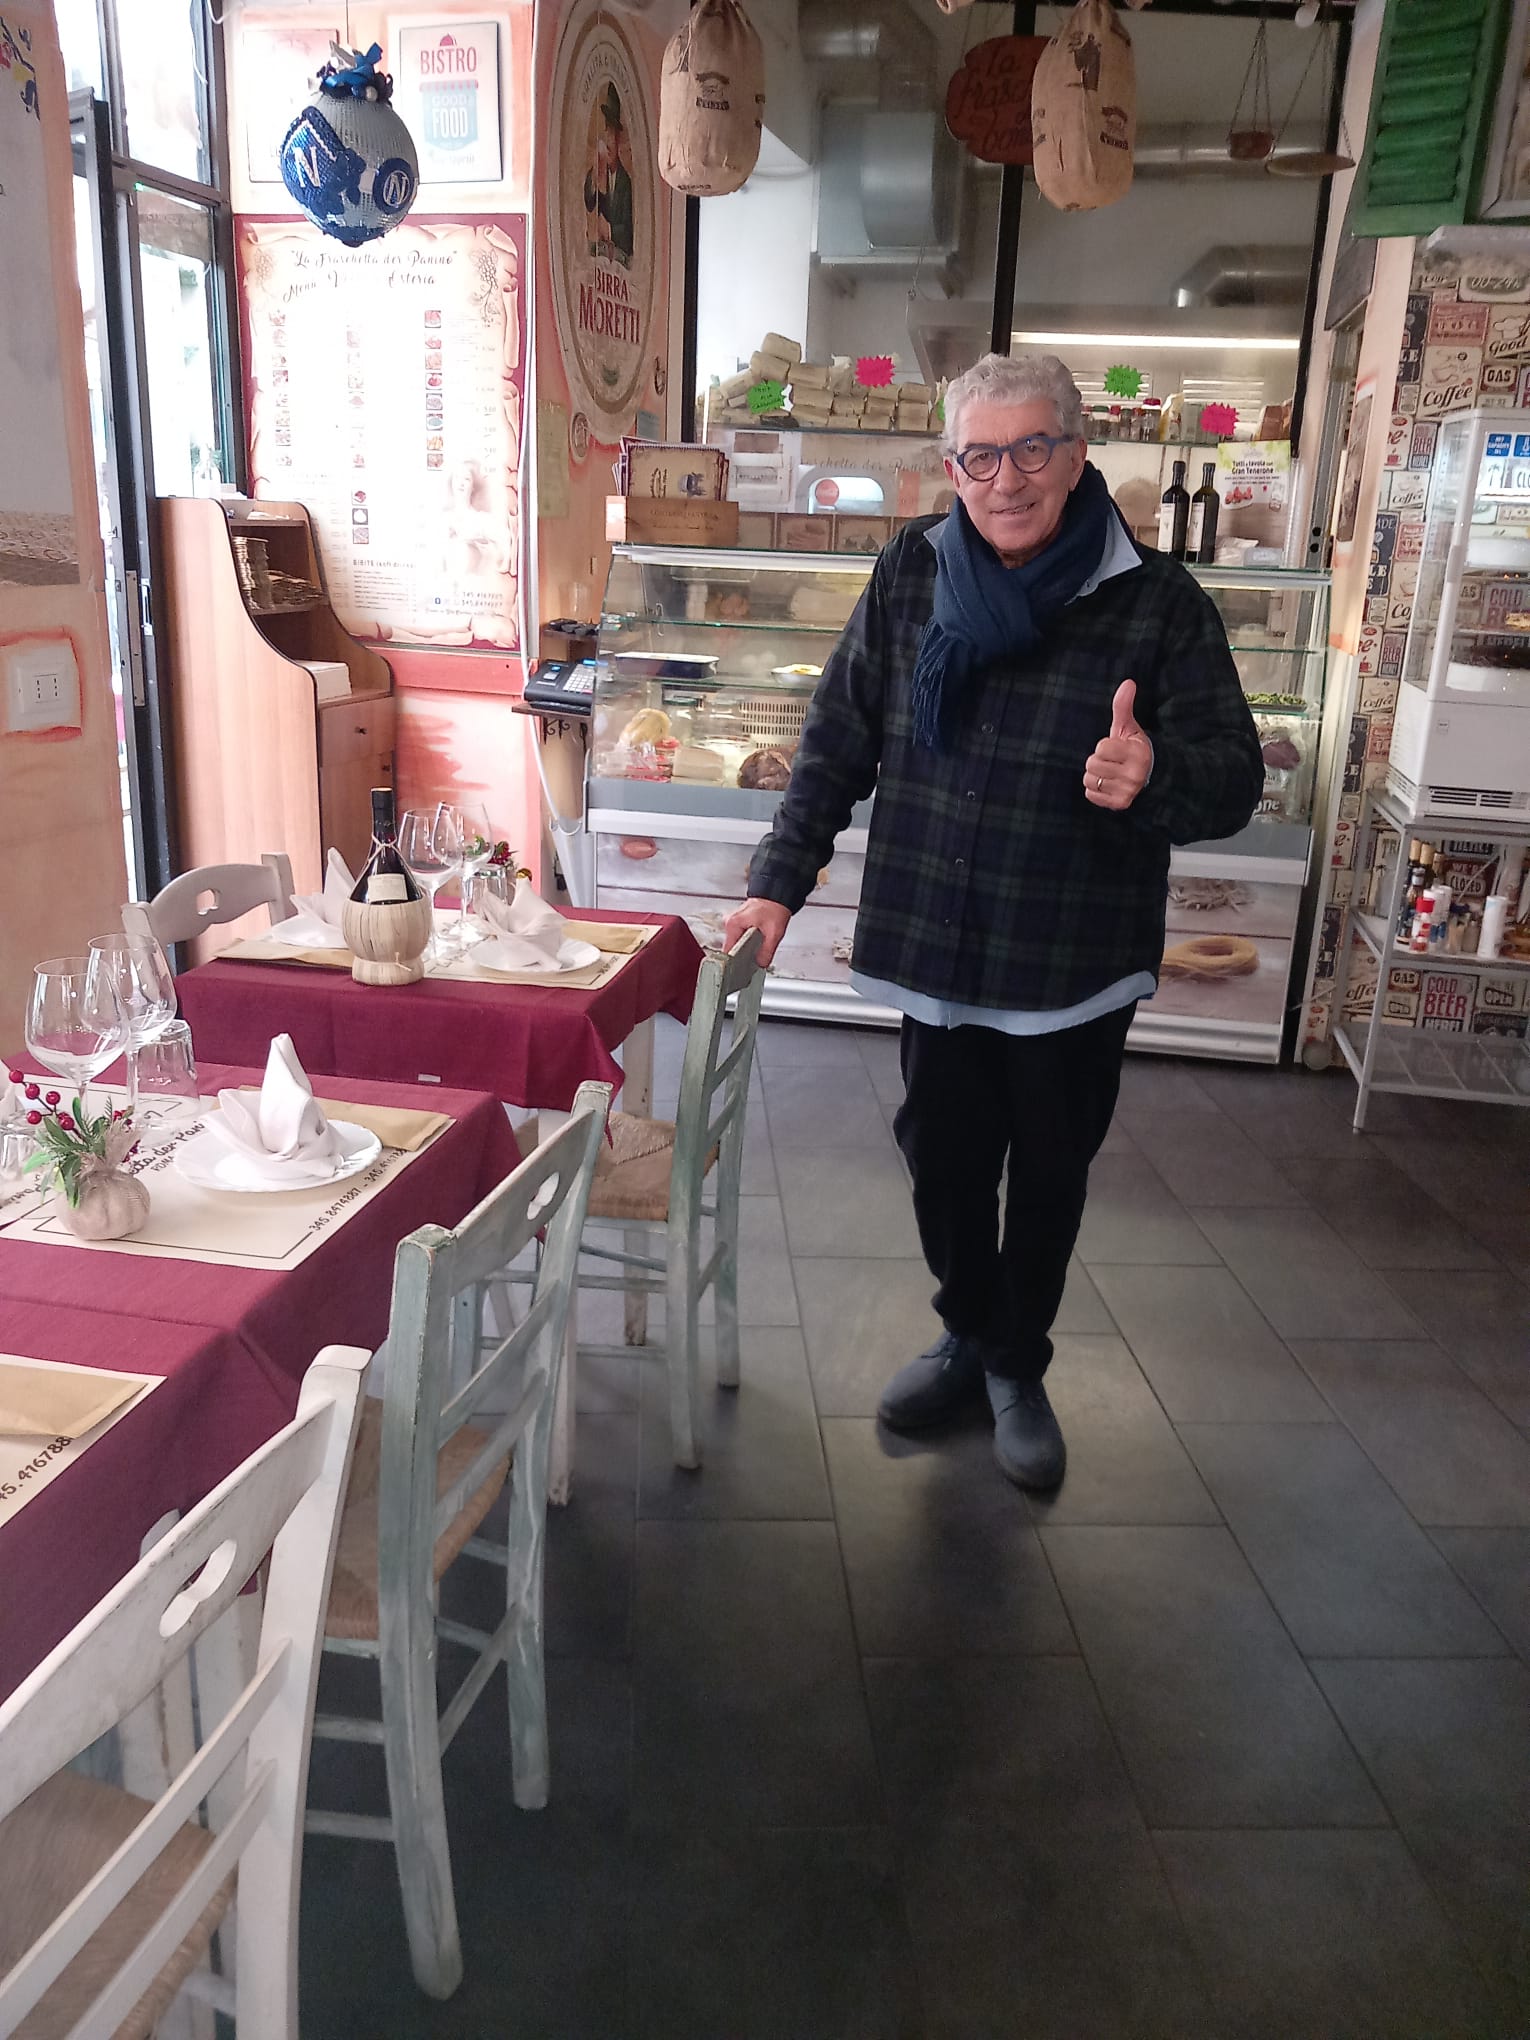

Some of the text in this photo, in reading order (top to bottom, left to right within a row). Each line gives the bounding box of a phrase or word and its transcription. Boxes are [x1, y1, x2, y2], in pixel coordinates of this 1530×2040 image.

[420, 47, 477, 74] BISTRO
[431, 95, 470, 107] GOOD
[431, 107, 468, 138] FOOD
[293, 147, 321, 188] N
[594, 265, 629, 302] BIRRA
[579, 282, 640, 344] MORETTI
[1488, 336, 1528, 356] Good
[1487, 369, 1511, 382] GAS
[1422, 384, 1473, 409] Coffee
[1231, 466, 1274, 475] Gran Tenerone
[1490, 589, 1523, 606] COLD
[1393, 973, 1415, 984] GAS
[1427, 977, 1458, 993] COLD
[1423, 993, 1468, 1018] BEER
